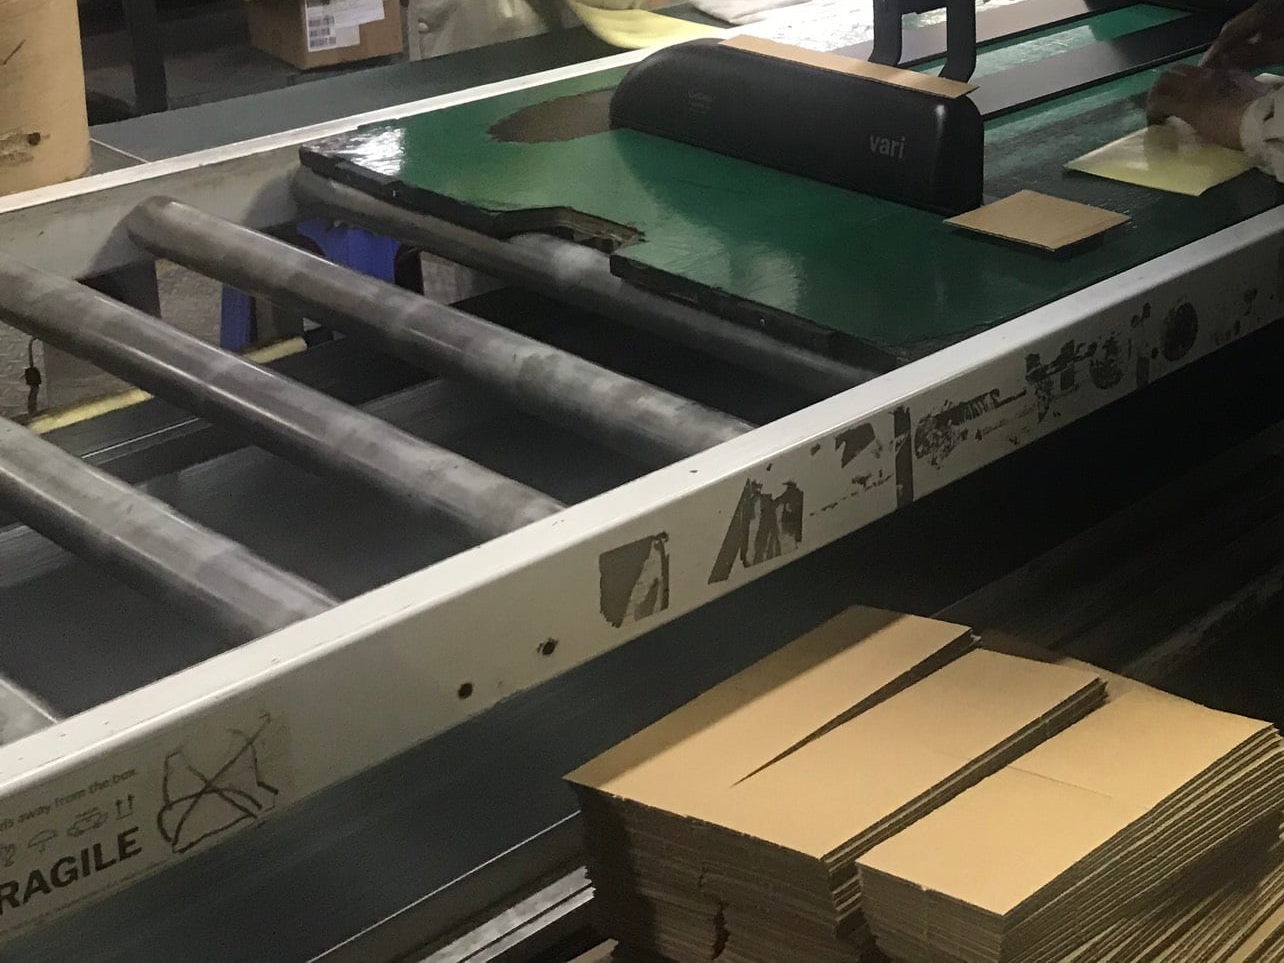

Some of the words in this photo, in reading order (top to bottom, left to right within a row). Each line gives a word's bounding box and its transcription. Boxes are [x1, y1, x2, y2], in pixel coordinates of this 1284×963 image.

[870, 135, 905, 158] vari
[55, 789, 87, 806] from
[89, 779, 110, 796] the
[113, 768, 136, 785] box
